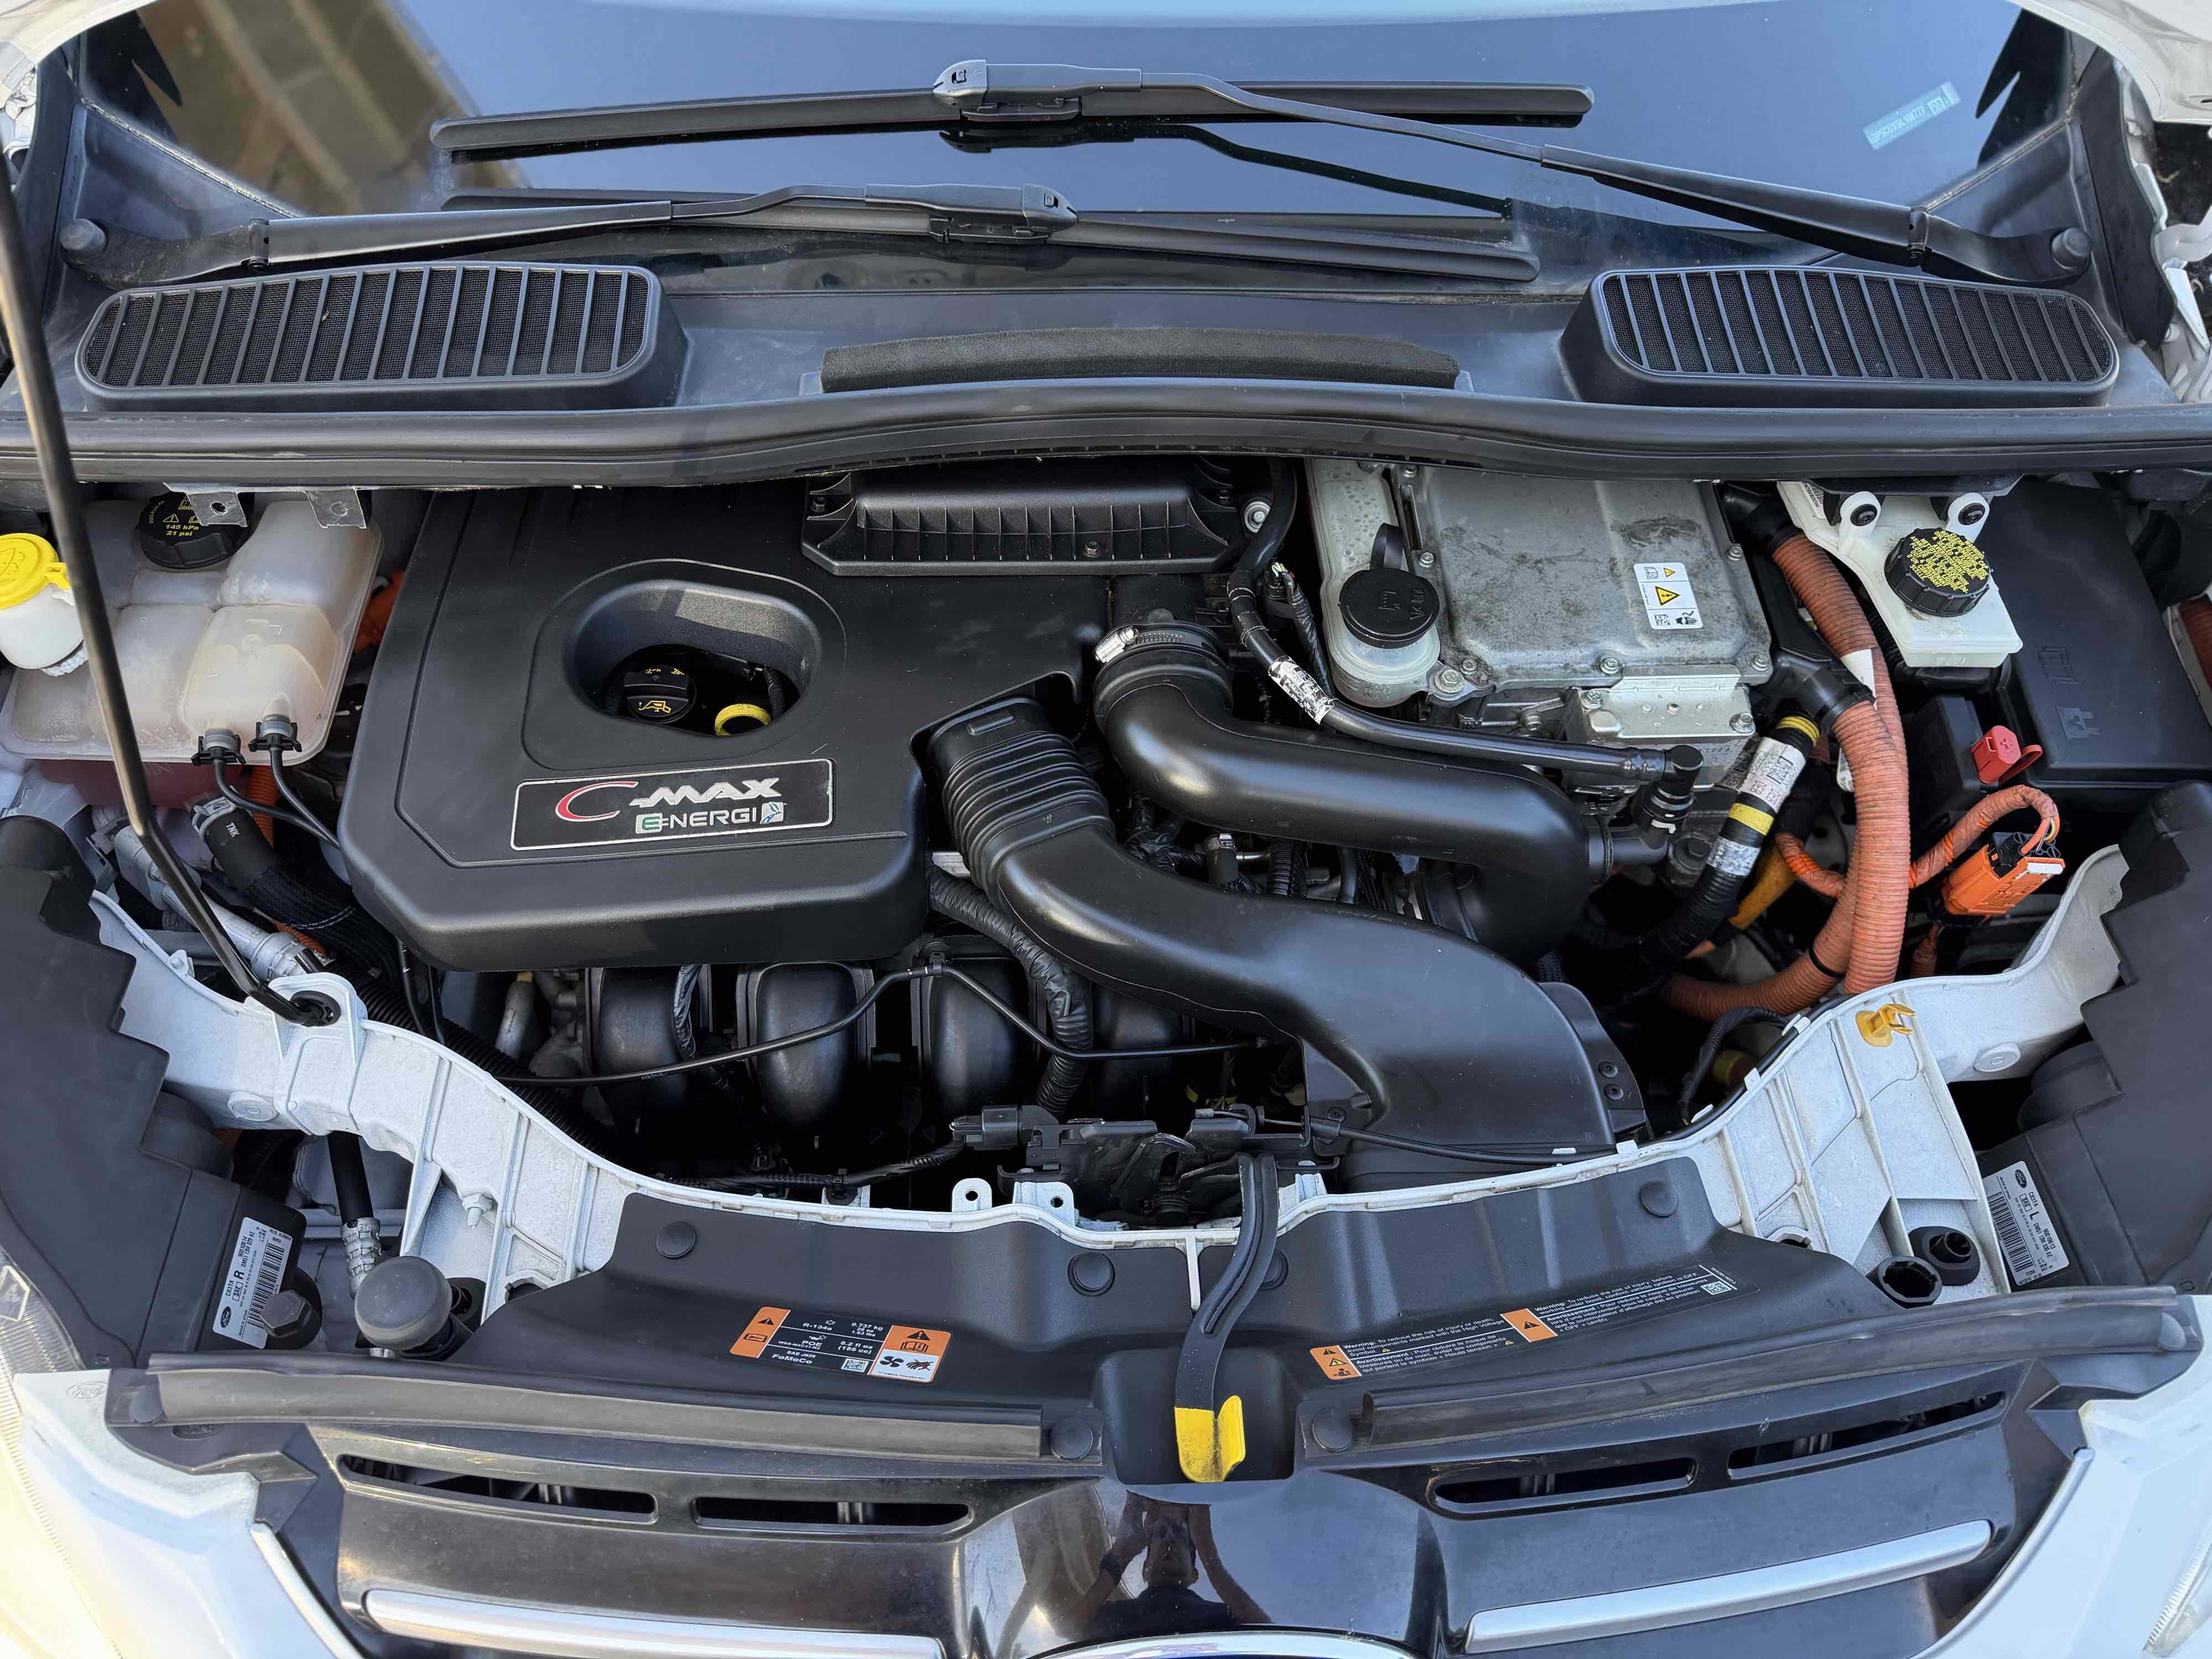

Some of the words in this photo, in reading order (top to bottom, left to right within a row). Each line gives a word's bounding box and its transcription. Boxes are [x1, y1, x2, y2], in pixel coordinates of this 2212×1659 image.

[226, 822, 240, 838] TNK
[2030, 1211, 2039, 1220] L
[234, 1270, 244, 1280] R
[773, 1354, 812, 1364] FoMoCo
